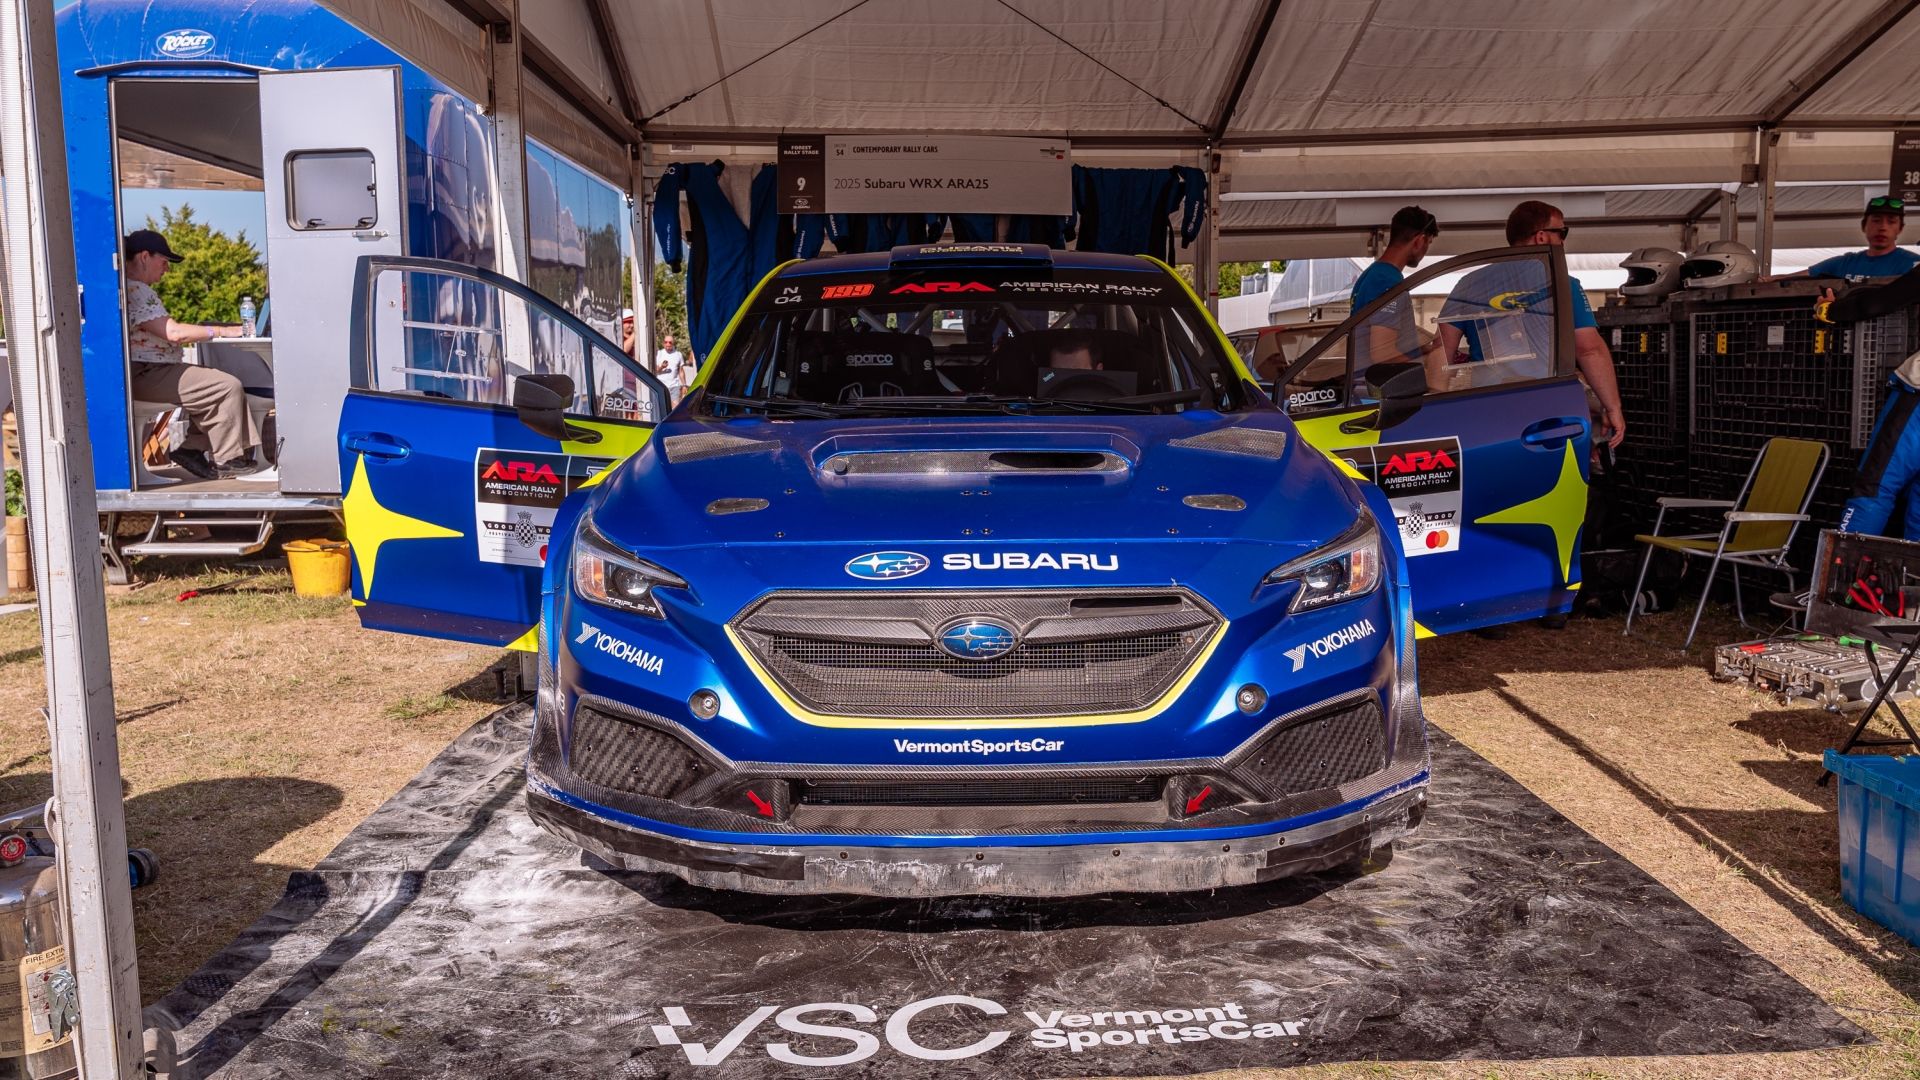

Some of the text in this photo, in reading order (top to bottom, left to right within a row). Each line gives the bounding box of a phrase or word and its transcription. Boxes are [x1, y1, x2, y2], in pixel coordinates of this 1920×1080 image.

[852, 145, 901, 153] CONTEMPORARY
[902, 145, 922, 153] RALLY
[924, 145, 938, 153] CARS
[797, 177, 806, 191] 9
[833, 178, 989, 189] 2025 Subaru WRX ARA25
[1903, 171, 1920, 185] 38
[783, 286, 799, 294] N
[821, 284, 875, 299] 199
[889, 281, 997, 294] ARA
[1000, 281, 1163, 293] AMERICAN RALLY
[1013, 287, 1156, 297] ASSOCIATION
[774, 295, 803, 305] 04
[846, 354, 894, 366] sparco
[604, 396, 653, 412] sparco
[1289, 388, 1337, 407] sparco
[1381, 449, 1457, 475] ARA
[481, 460, 561, 484] ARA
[1384, 470, 1453, 484] AMERICAN RALLY
[484, 482, 557, 494] AMERICAN RALLY
[1427, 513, 1453, 521] WOOD
[943, 553, 1119, 571] SUBARU
[606, 596, 656, 614] TRIPLE-R
[1301, 590, 1352, 607] TRIPLE-R
[1306, 618, 1376, 660] YOKOHAMA
[594, 631, 664, 676] YOKOHAMA
[894, 738, 1064, 756] VermontSportsCar
[25, 954, 44, 965] FIRE
[1021, 1001, 1247, 1028] Vermont
[651, 994, 1011, 1067] VSC
[1029, 1017, 1304, 1054] SportsCar
